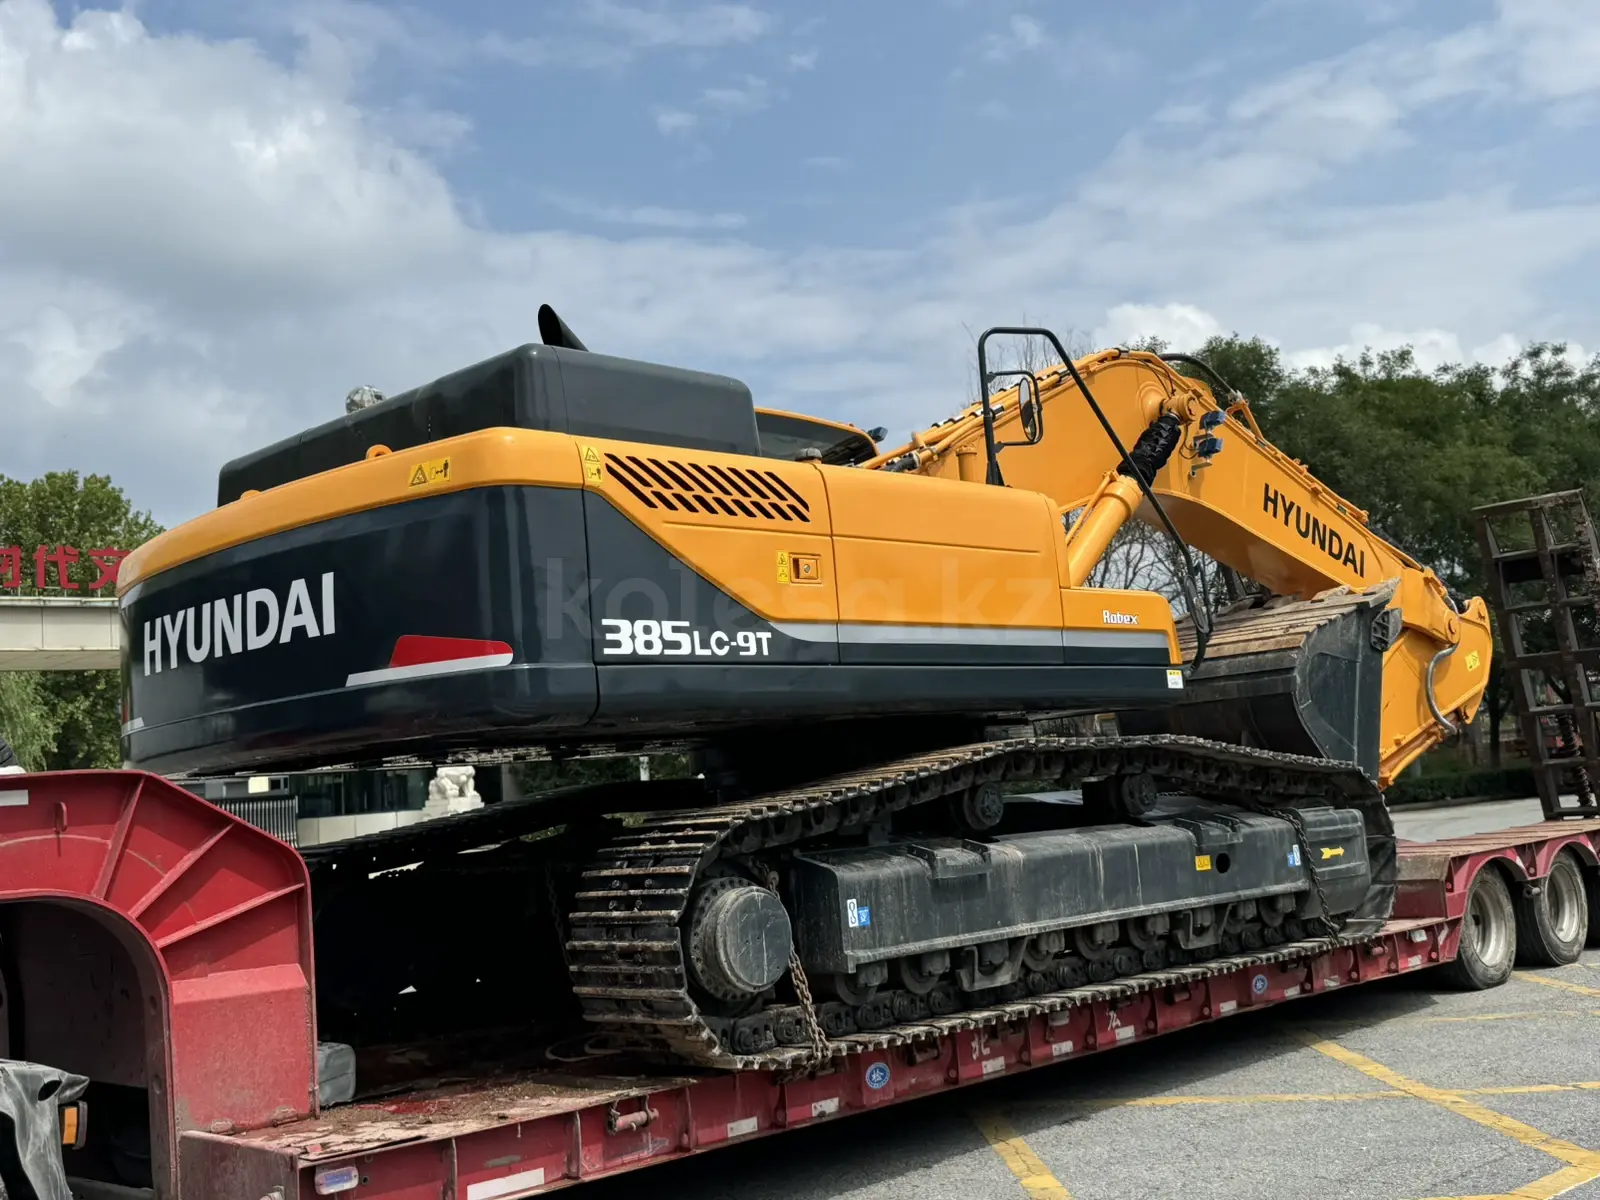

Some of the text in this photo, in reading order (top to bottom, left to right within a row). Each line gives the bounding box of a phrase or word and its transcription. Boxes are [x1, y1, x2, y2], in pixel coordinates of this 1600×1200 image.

[1263, 482, 1364, 579] HYUNDAI
[144, 571, 336, 677] HYUNDAI
[1102, 609, 1139, 625] Robex
